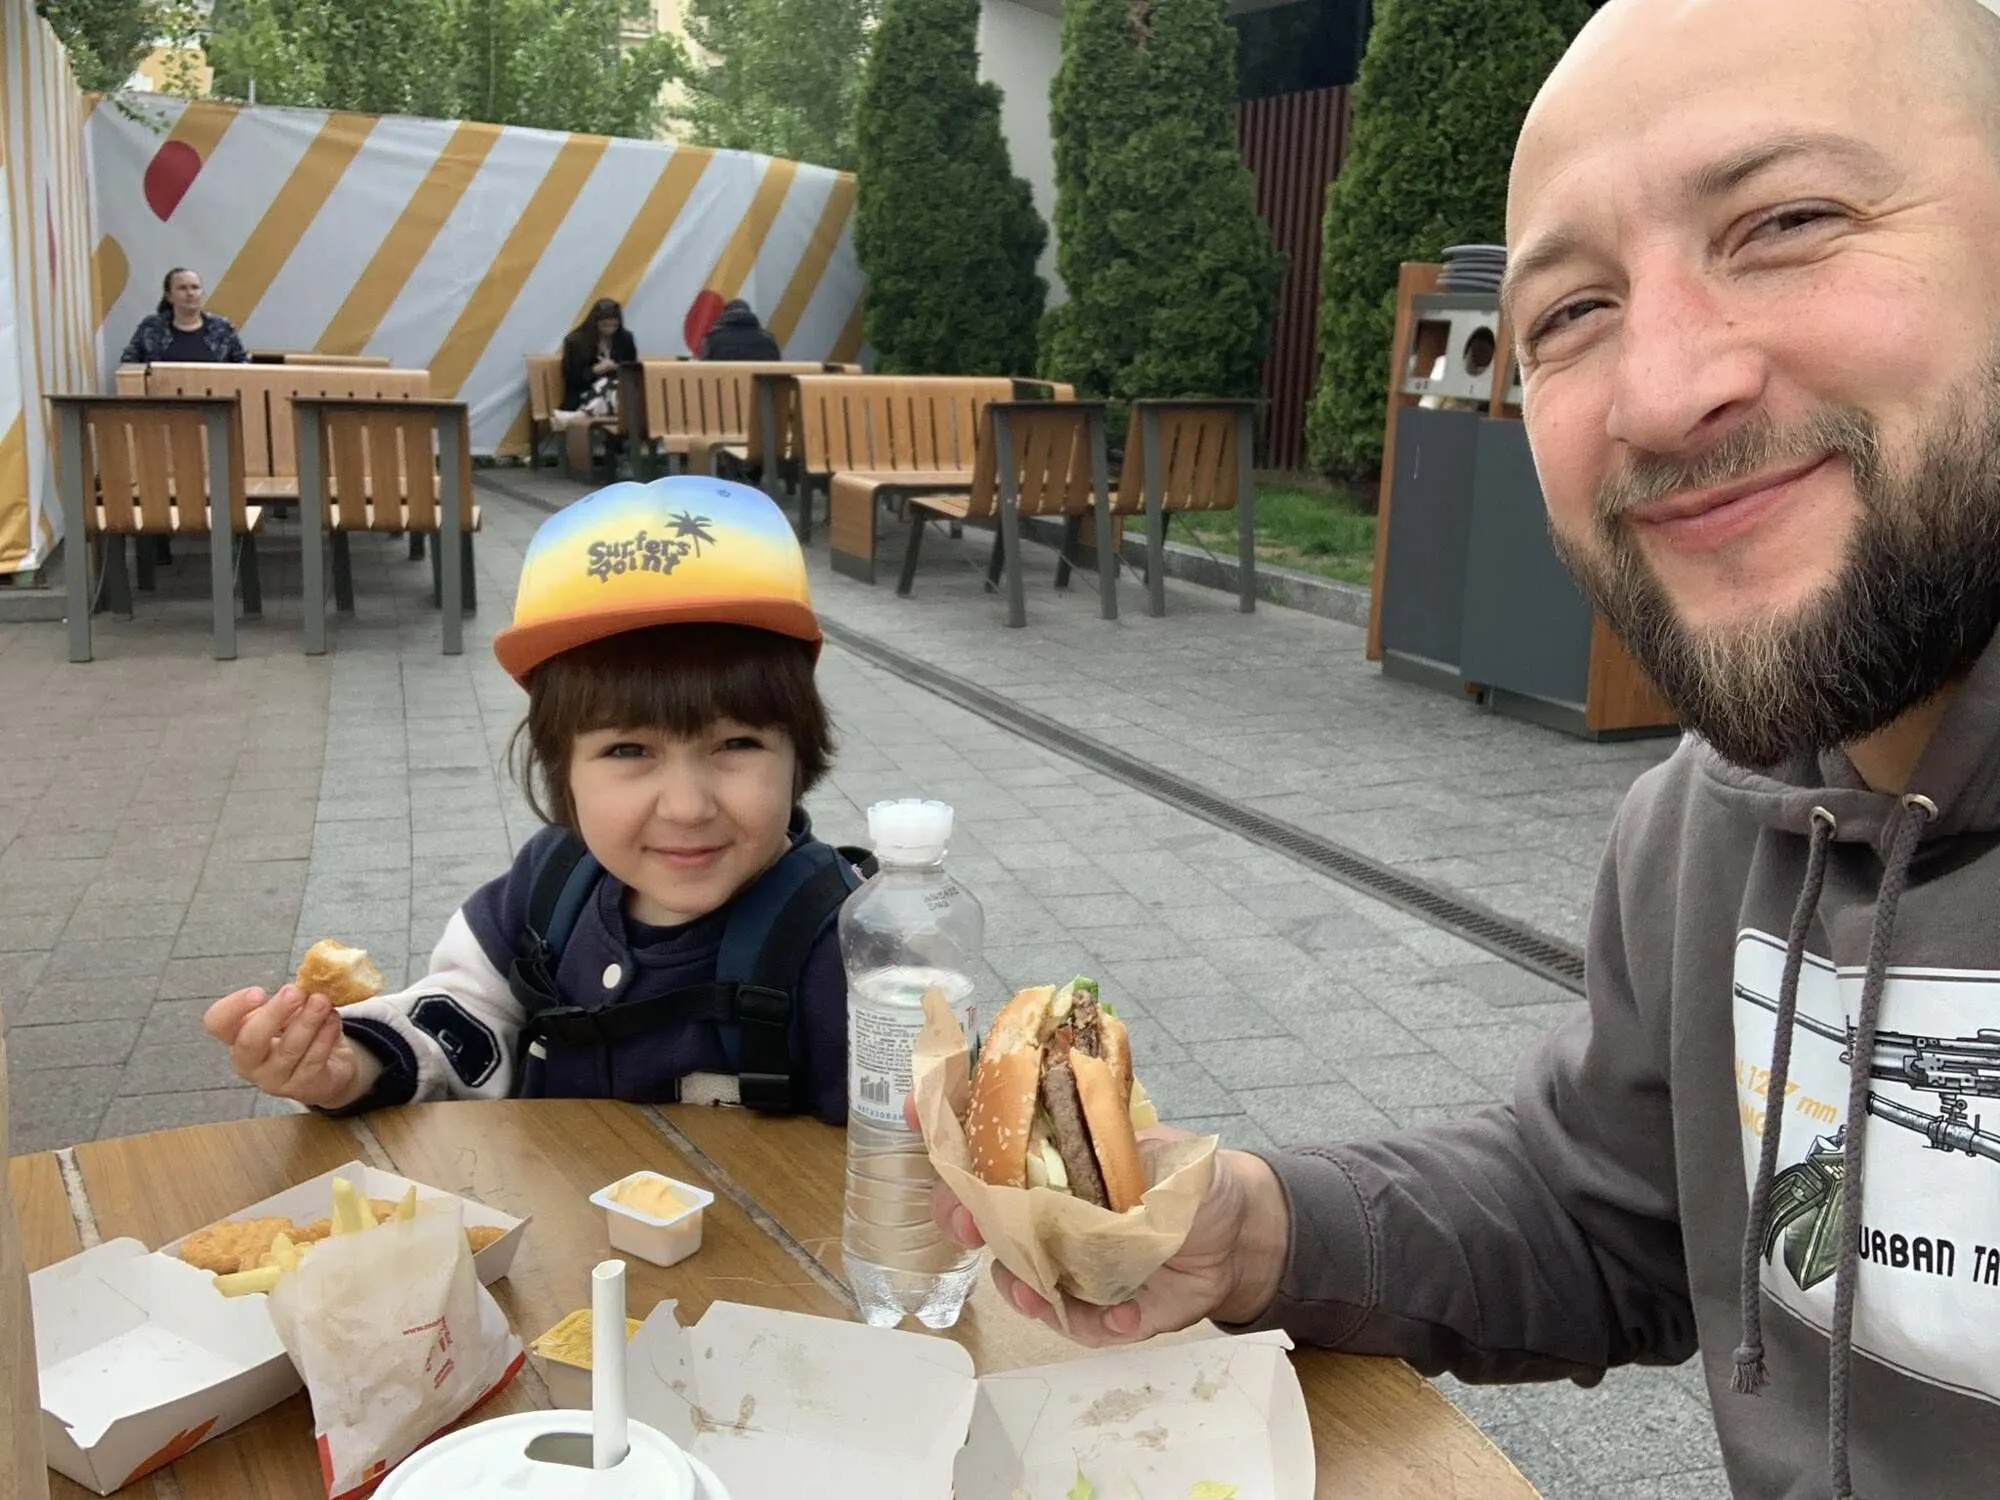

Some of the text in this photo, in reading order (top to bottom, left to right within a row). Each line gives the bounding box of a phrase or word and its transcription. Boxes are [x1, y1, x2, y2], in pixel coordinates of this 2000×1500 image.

[587, 530, 691, 565] Surfers
[1796, 1096, 1838, 1124] mm
[1859, 1224, 1955, 1277] URBAN
